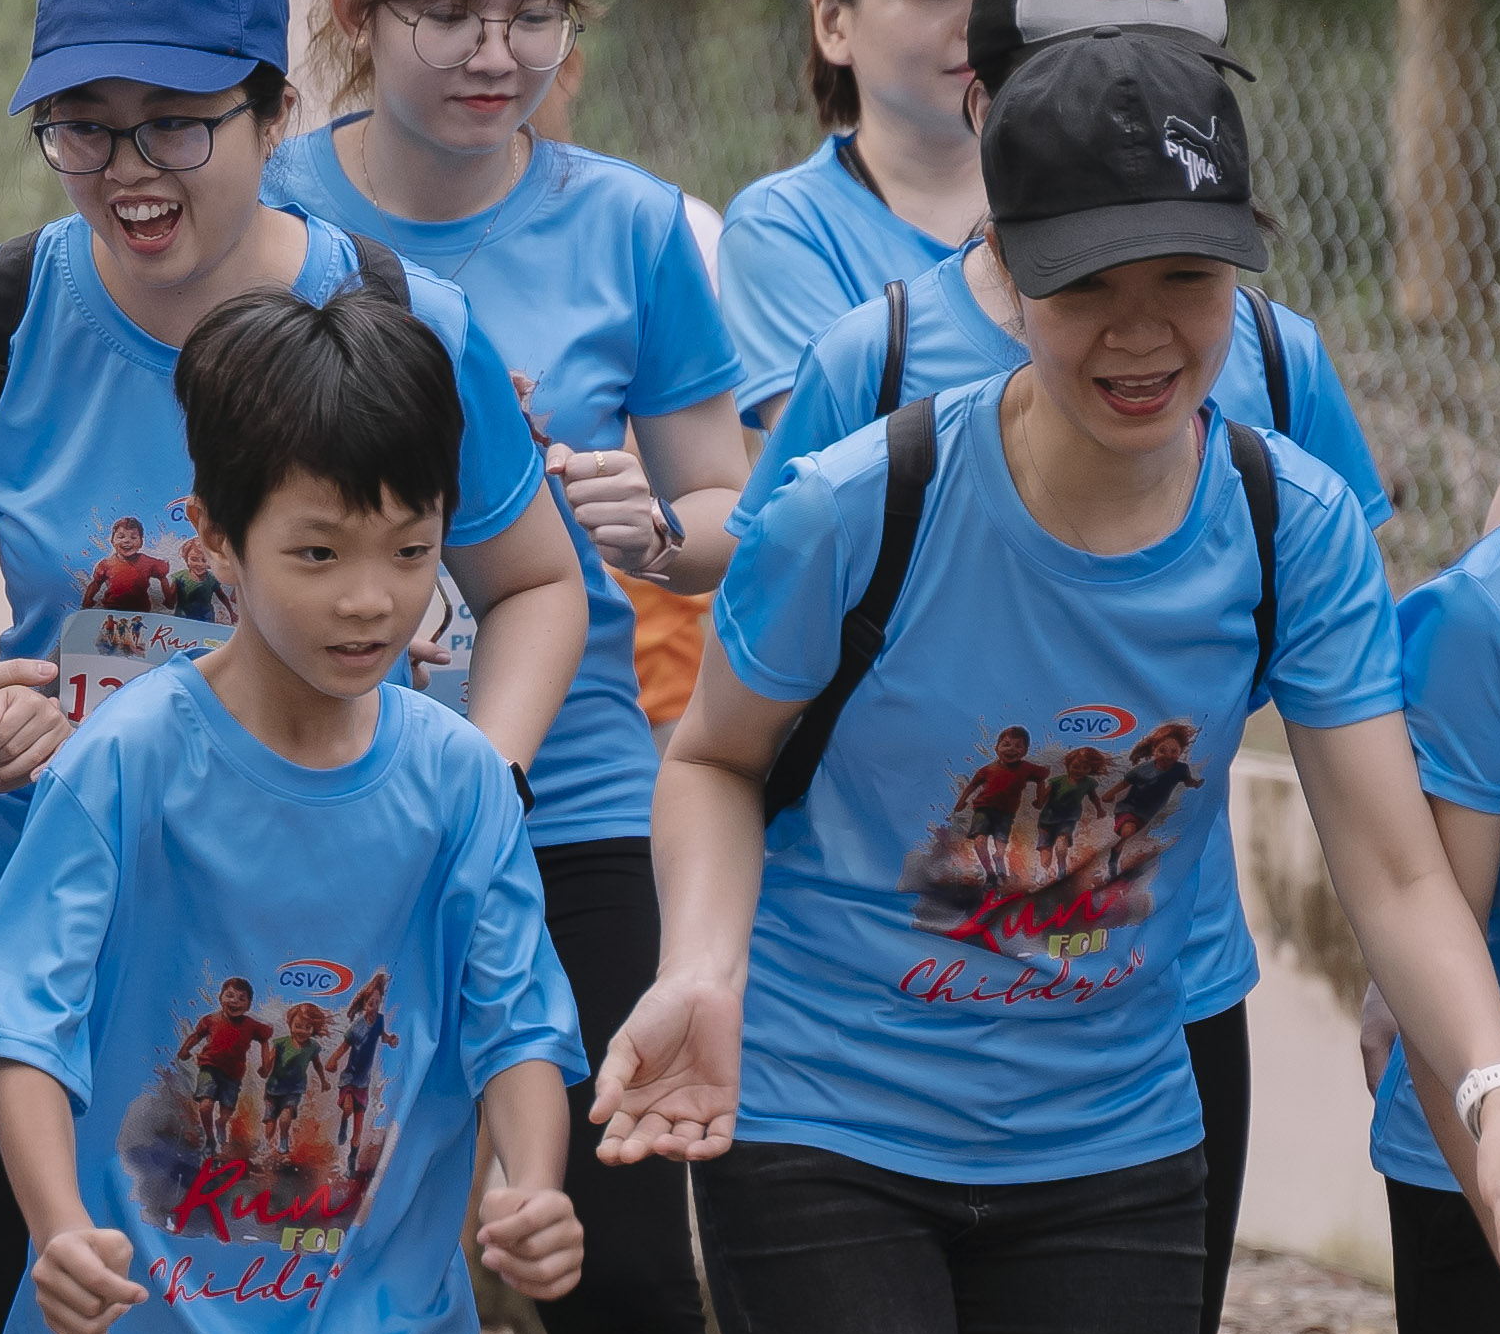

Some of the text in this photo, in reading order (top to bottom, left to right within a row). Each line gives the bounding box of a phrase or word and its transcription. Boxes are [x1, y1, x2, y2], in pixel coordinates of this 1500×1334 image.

[1164, 139, 1219, 192] PUMA
[151, 624, 198, 653] Run
[1058, 717, 1112, 734] CSVC
[279, 969, 332, 990] CSVC
[900, 943, 1147, 1005] Children
[172, 1156, 362, 1245] Run
